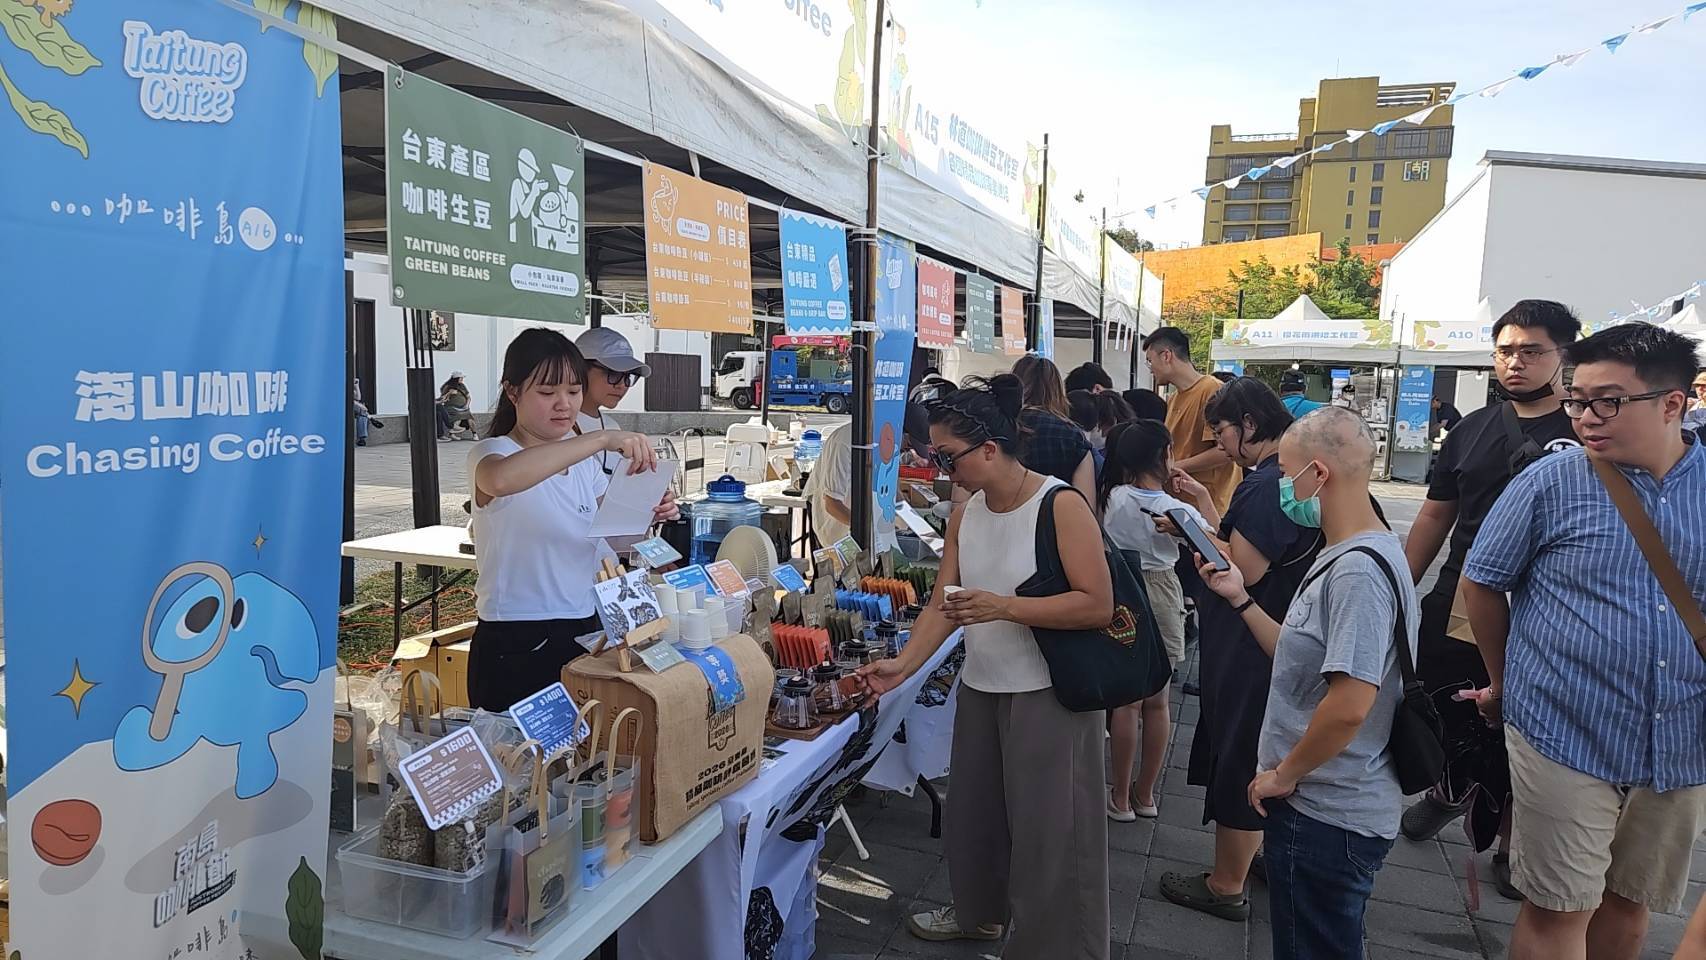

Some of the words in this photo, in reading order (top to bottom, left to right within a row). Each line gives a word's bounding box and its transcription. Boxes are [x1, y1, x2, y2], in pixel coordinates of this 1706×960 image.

[124, 21, 247, 88] Taitung
[140, 75, 235, 123] Coffee
[915, 103, 939, 145] A15
[402, 127, 491, 182] 台東產區
[402, 181, 492, 230] 咖啡生豆
[716, 199, 746, 223] PRICE
[404, 236, 460, 258] TAITUNG
[463, 247, 506, 266] COFFEE
[404, 256, 449, 275] GREEN
[451, 263, 490, 281] BEANS
[1252, 330, 1273, 339] A11
[1447, 331, 1474, 340] A10
[872, 383, 905, 401] 豆工作室
[26, 435, 200, 478] Chasing
[208, 429, 326, 462] Coffee
[539, 687, 563, 706] $1400
[439, 733, 473, 758] $1600
[697, 760, 726, 781] 2026
